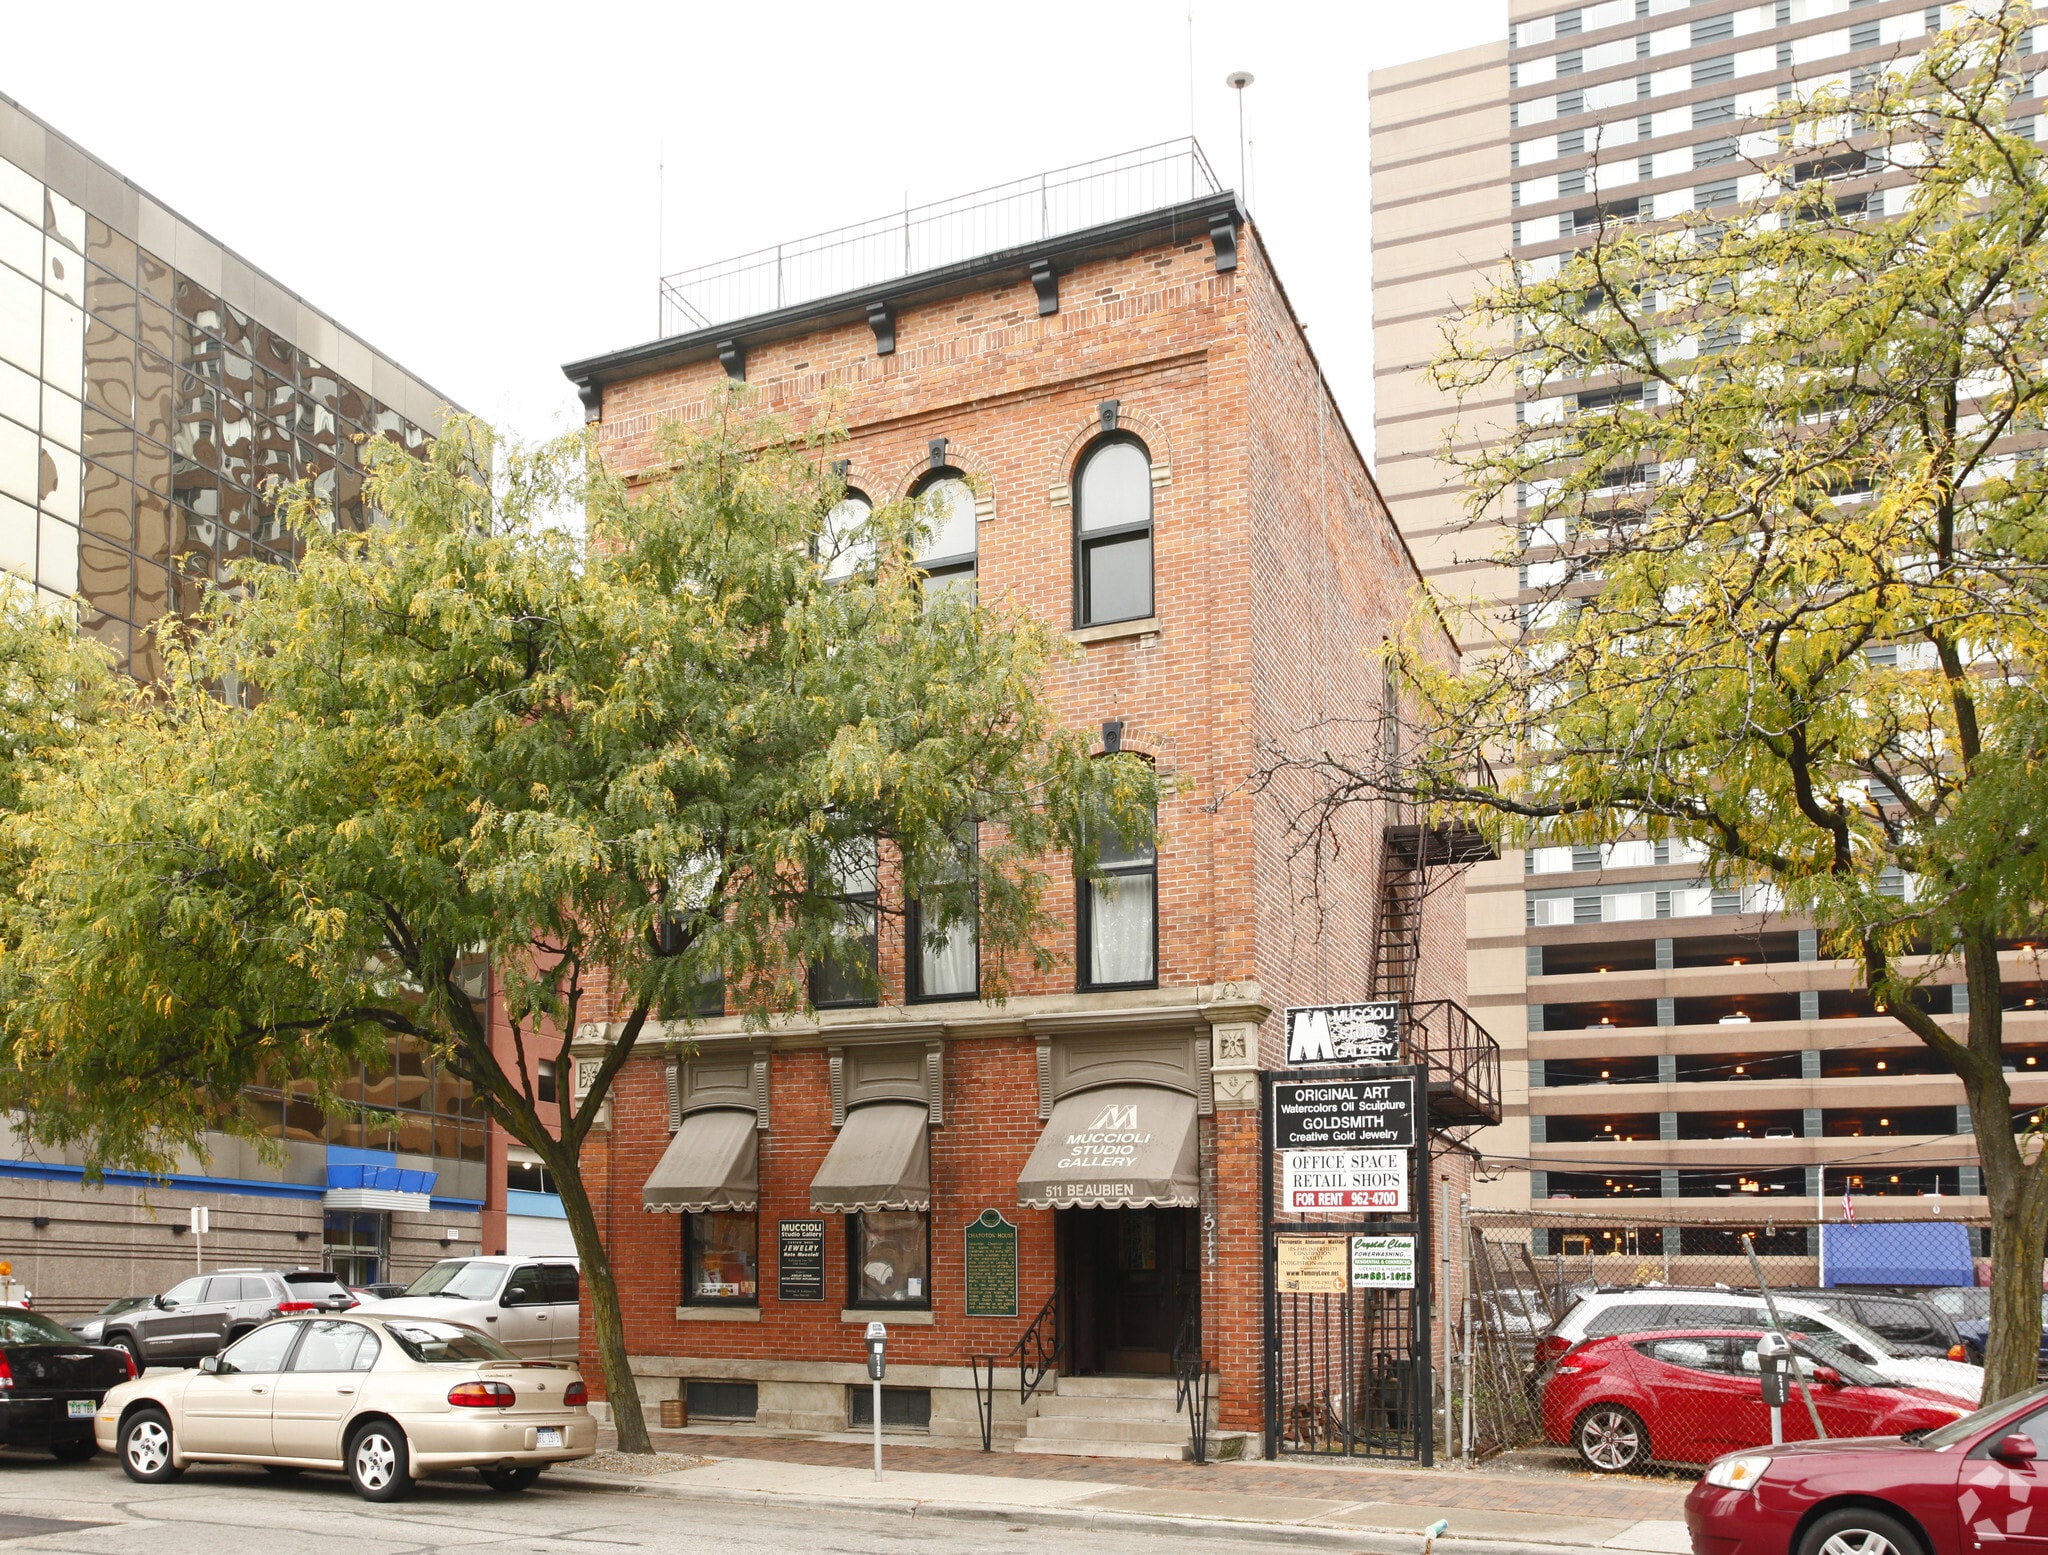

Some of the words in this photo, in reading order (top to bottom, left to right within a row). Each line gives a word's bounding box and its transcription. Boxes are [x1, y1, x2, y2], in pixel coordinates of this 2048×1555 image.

[1333, 1007, 1395, 1022] MUCCIOLI
[1339, 1025, 1388, 1040] STUDIO
[1336, 1043, 1394, 1058] GALLERY
[1295, 1087, 1358, 1102] ORIGINAL
[1363, 1086, 1391, 1099] ART
[1281, 1103, 1337, 1114] Watercolors
[1341, 1101, 1354, 1111] Oil
[1358, 1100, 1406, 1112] Sculpture
[1302, 1115, 1384, 1130] GOLDSMITH
[1066, 1133, 1151, 1145] MUCCIOLI
[1289, 1131, 1329, 1142] Creative
[1333, 1130, 1356, 1141] Gold
[1360, 1129, 1398, 1141] Jewelry
[1070, 1145, 1134, 1156] STUDIO
[1057, 1156, 1138, 1169] GALLERY
[1292, 1155, 1345, 1169] OFFICE
[1351, 1154, 1397, 1168] SPACE
[1293, 1174, 1347, 1188] RETAIL
[1352, 1173, 1400, 1187] SHOPS
[1045, 1184, 1062, 1197] 511
[1066, 1184, 1134, 1197] BEAUBIEN
[1295, 1192, 1315, 1206] FOR
[1318, 1192, 1344, 1206] RENT
[1351, 1191, 1396, 1206] 962-4700
[781, 1223, 822, 1232] MUCCIOLI
[1203, 1213, 1216, 1266] 511
[783, 1244, 819, 1252] JEWELRY
